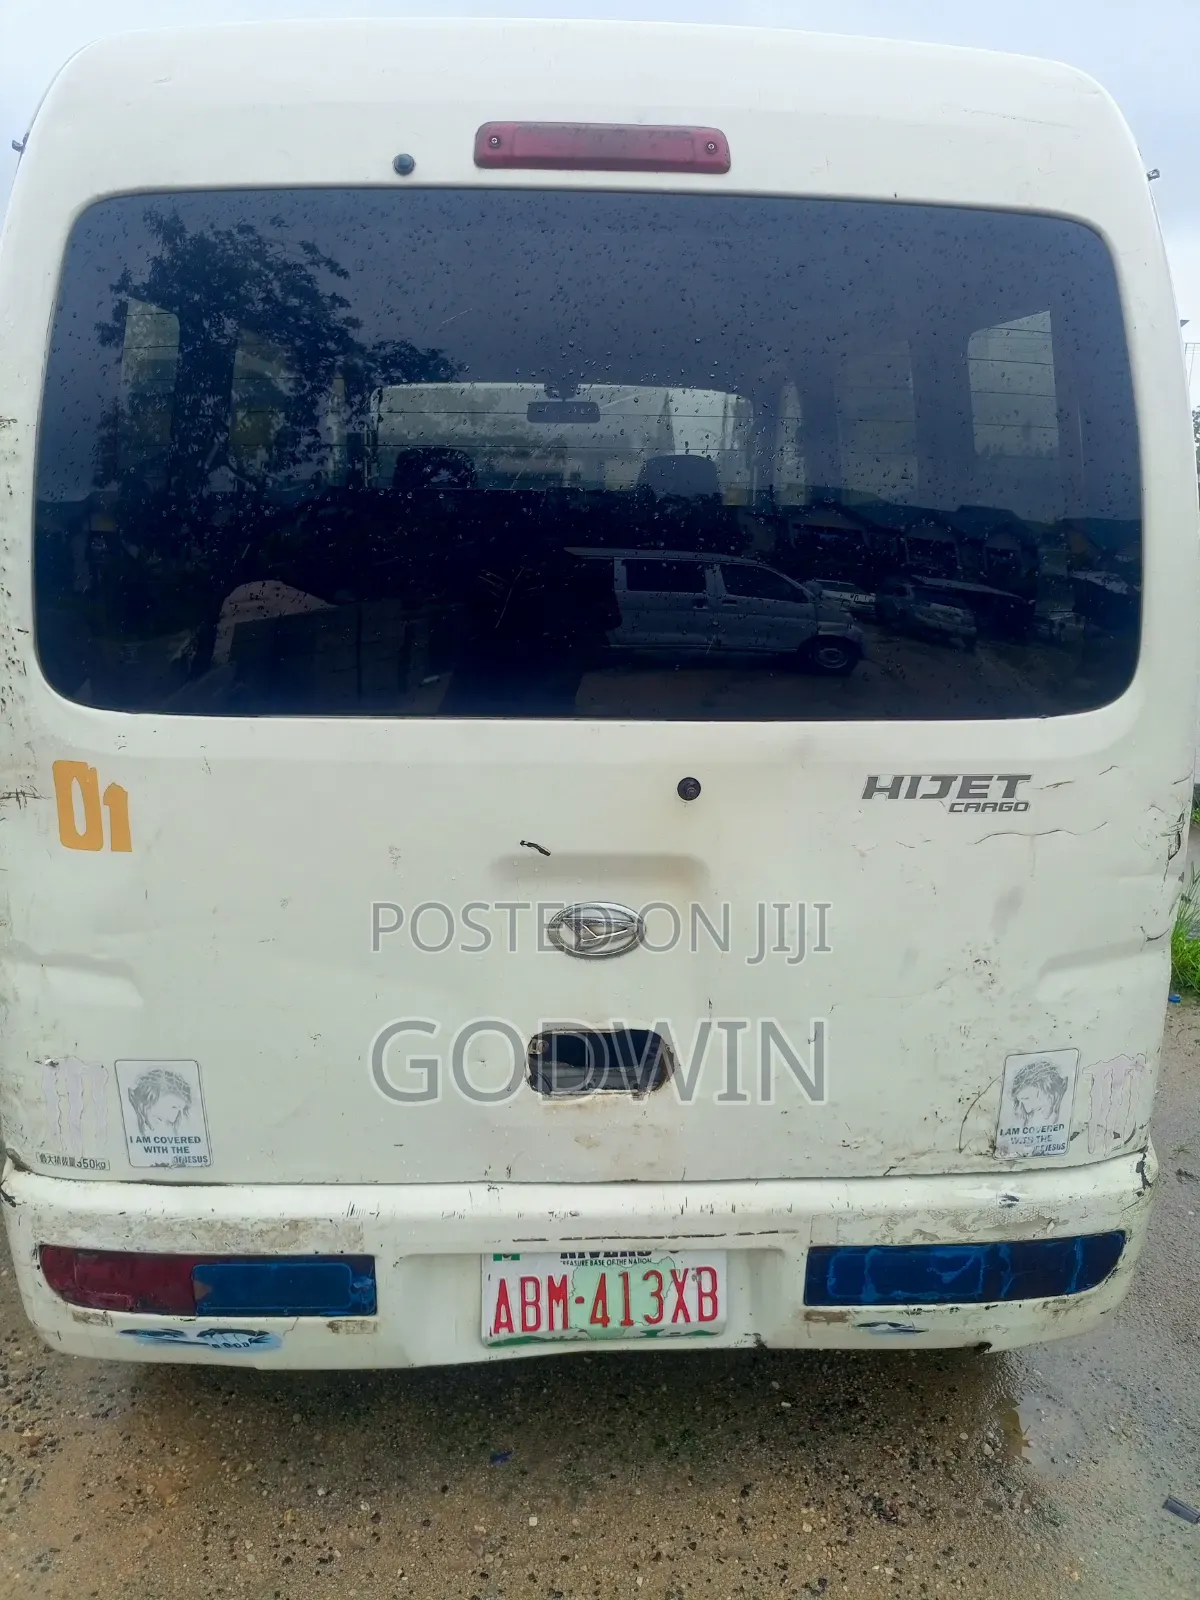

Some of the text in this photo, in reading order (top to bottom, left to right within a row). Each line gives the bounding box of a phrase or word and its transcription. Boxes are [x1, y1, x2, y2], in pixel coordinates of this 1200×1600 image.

[861, 775, 1032, 799] HIJET
[52, 760, 132, 852] 01
[948, 801, 1029, 813] CARGO
[1005, 1128, 1020, 1136] AM
[135, 1136, 151, 1144] AM
[153, 1136, 202, 1144] COVERED
[143, 1146, 190, 1154] WITH THE
[1045, 1142, 1067, 1152] JESUS
[182, 1155, 209, 1164] JESUS
[590, 1259, 605, 1267] BASE
[628, 1257, 652, 1265] NATION
[492, 1266, 719, 1334] ABM-413XB
